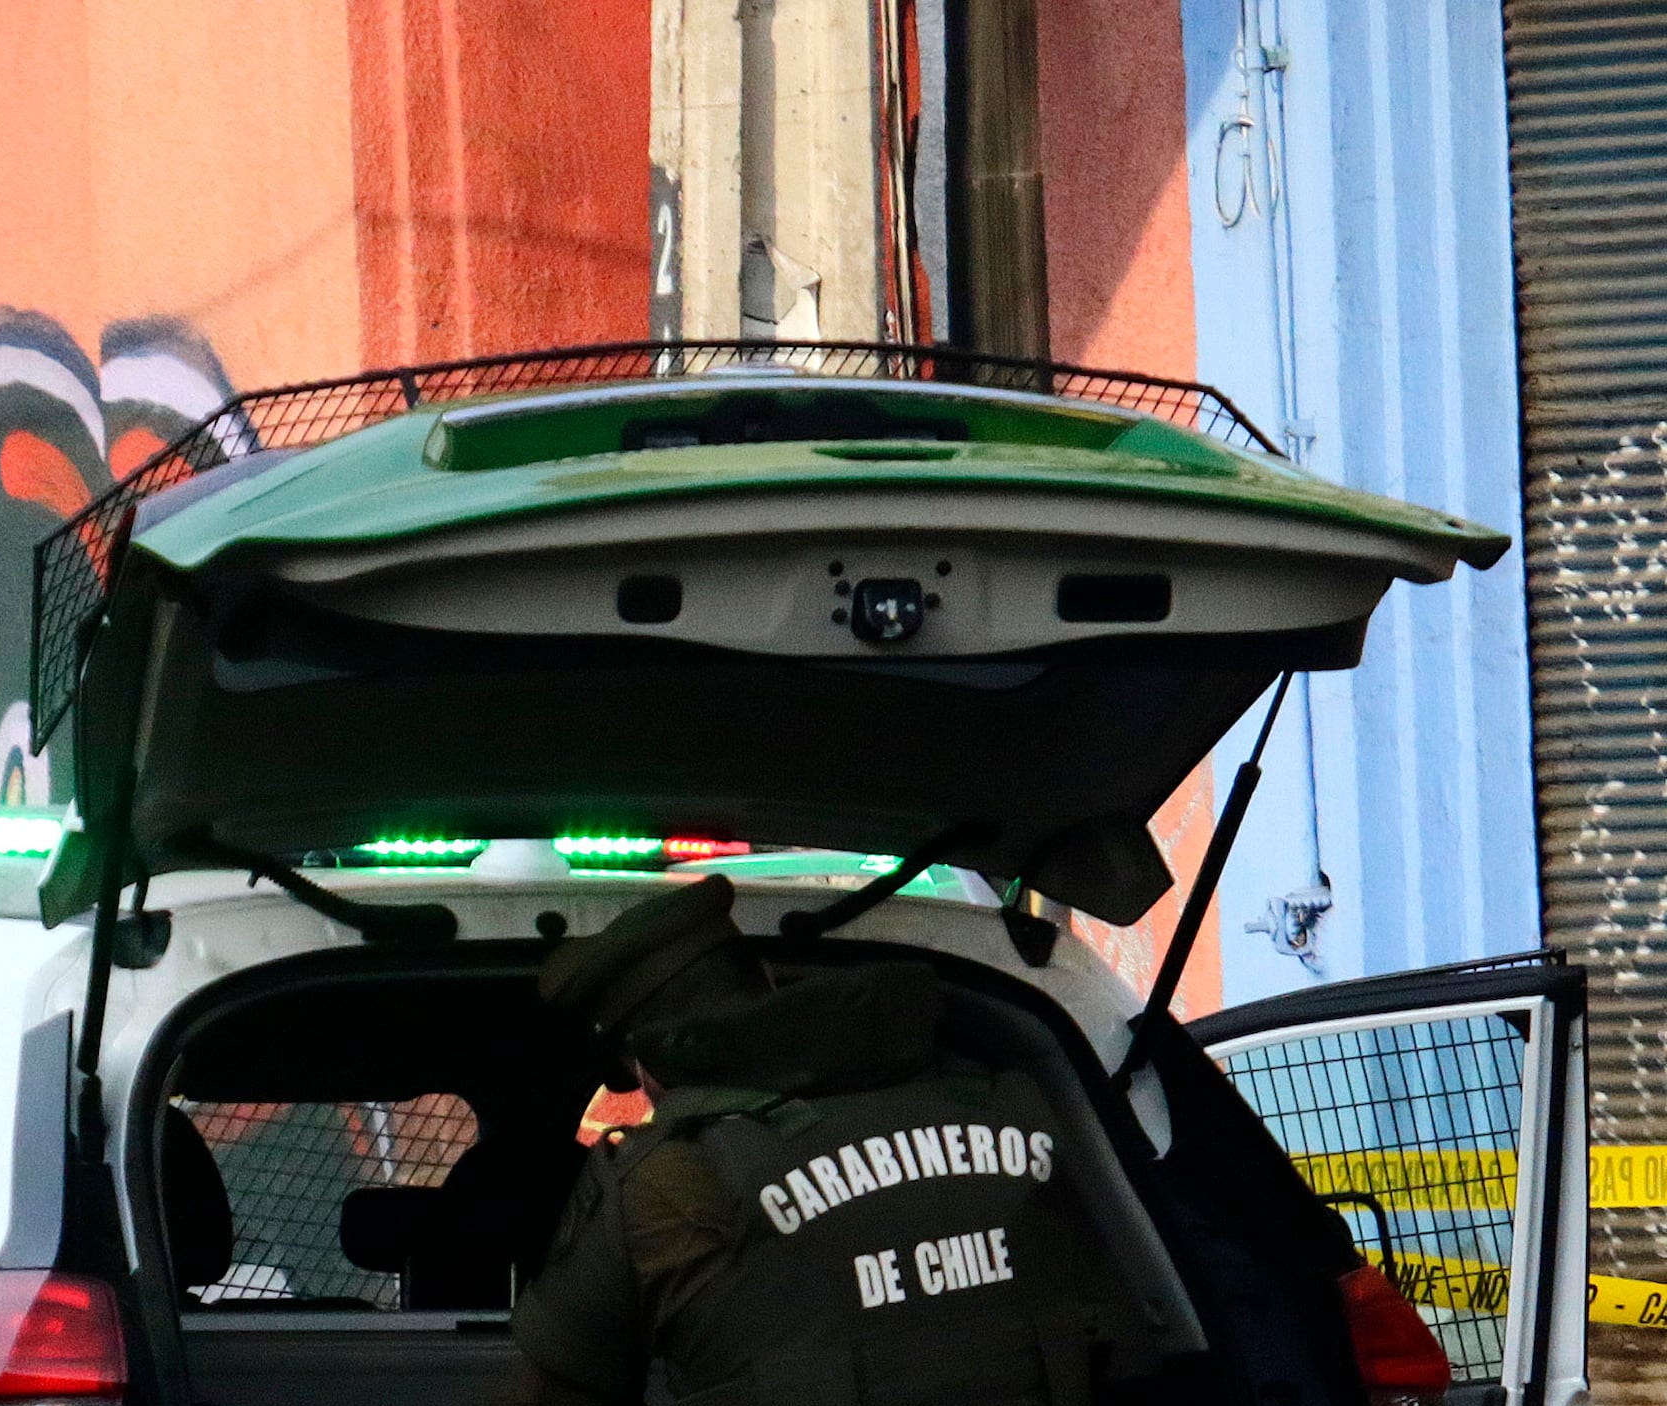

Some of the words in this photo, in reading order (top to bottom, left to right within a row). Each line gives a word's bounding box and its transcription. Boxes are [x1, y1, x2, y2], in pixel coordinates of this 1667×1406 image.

[759, 1124, 1054, 1235] CARABINEROS
[854, 1249, 907, 1309] DE
[915, 1227, 1014, 1296] CHILE
